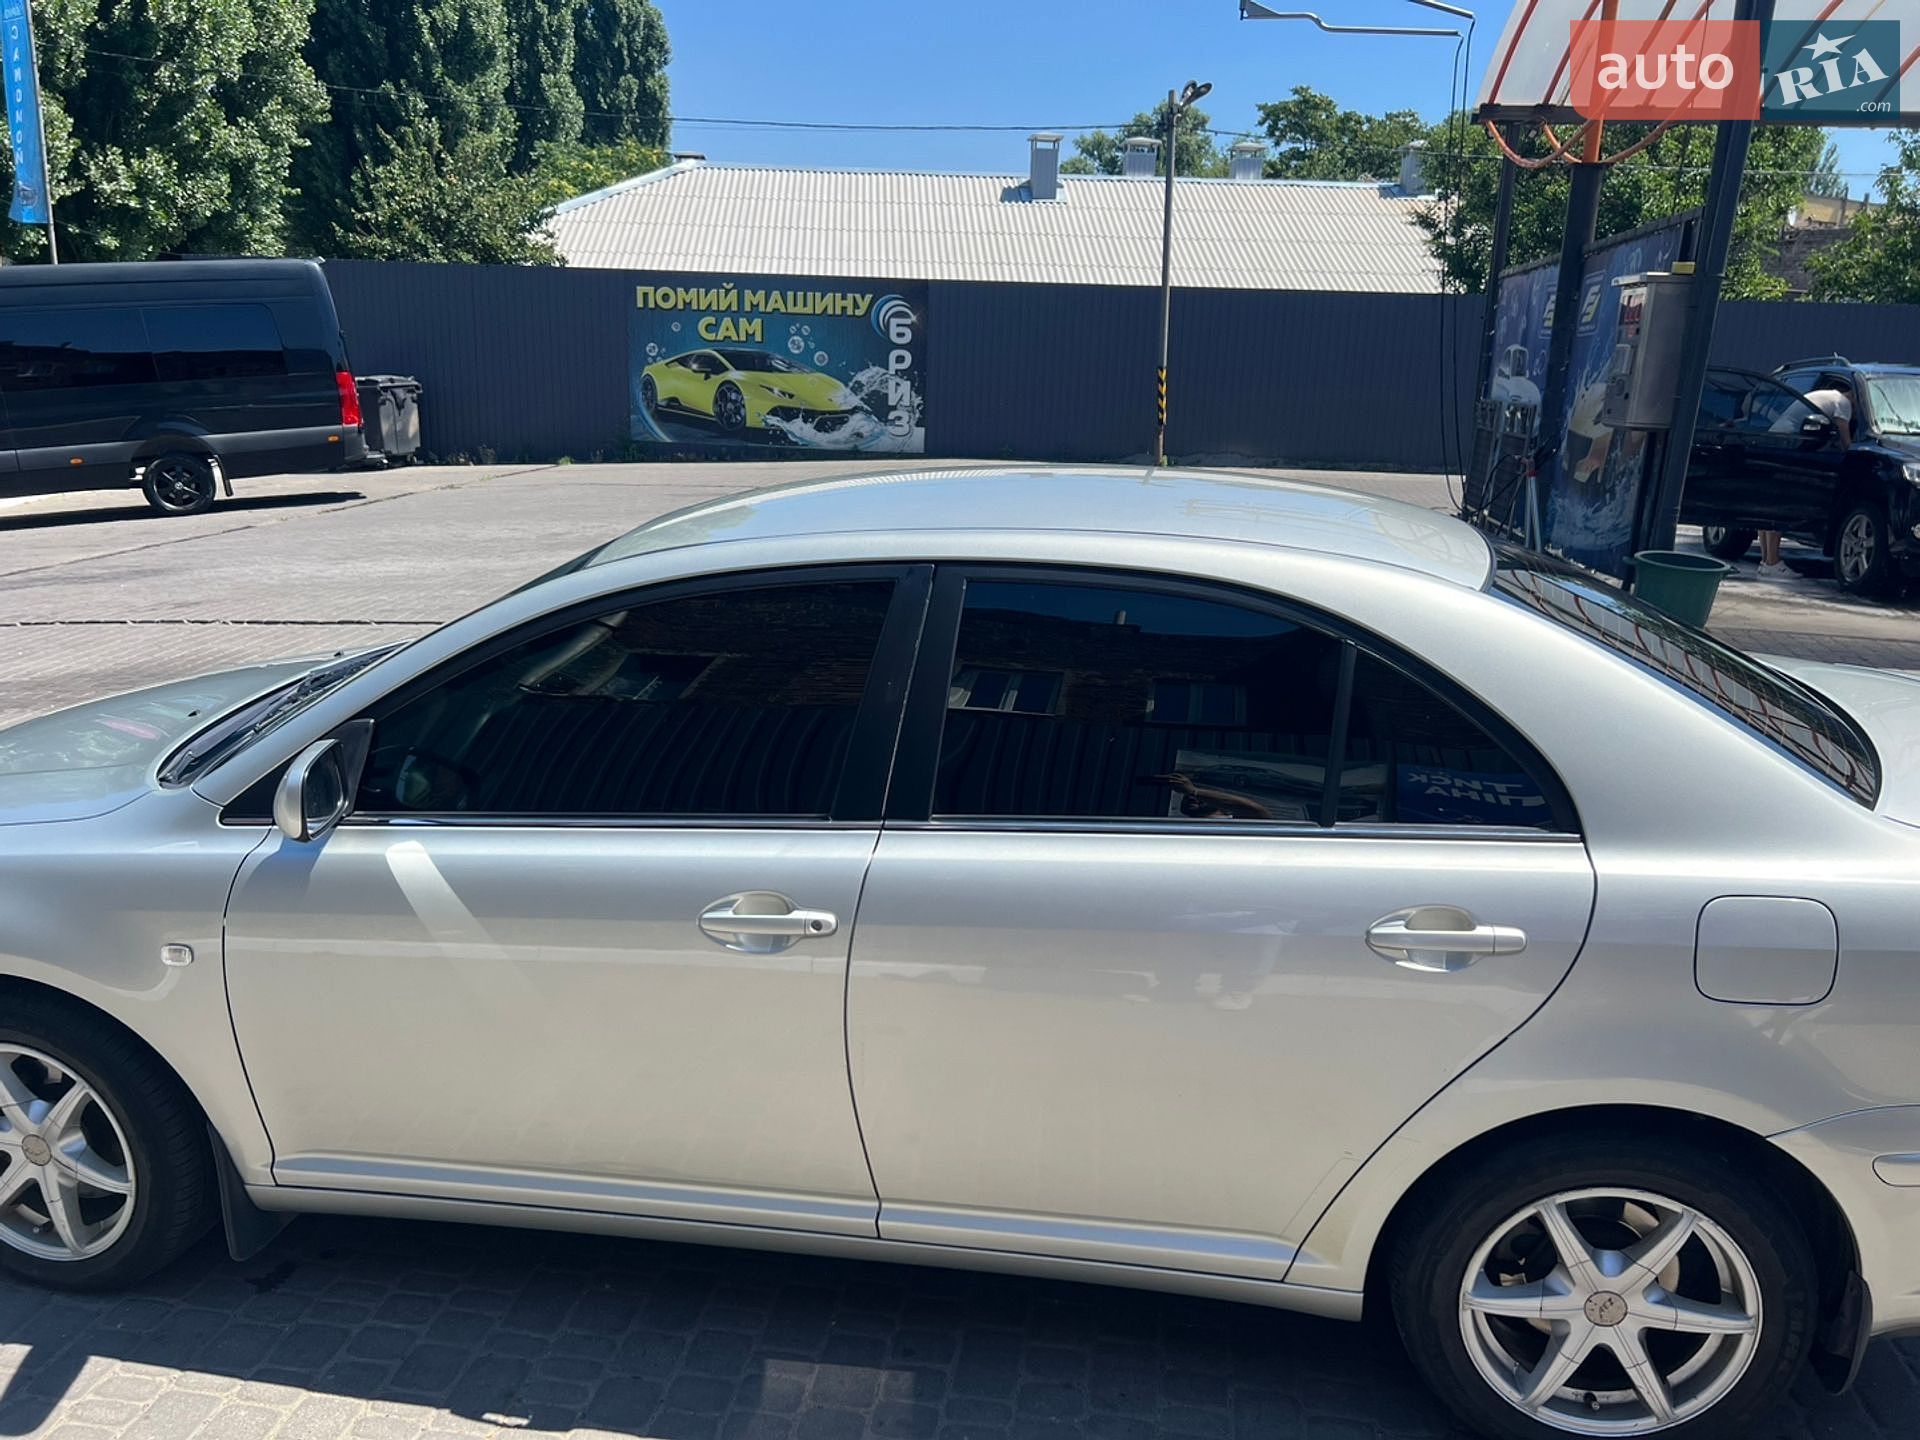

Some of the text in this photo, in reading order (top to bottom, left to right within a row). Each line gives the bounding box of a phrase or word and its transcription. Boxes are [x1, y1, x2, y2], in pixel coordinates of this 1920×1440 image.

[636, 283, 874, 318] ПОМИЙ МАШИНУ
[697, 317, 763, 342] САМ
[887, 317, 912, 436] БРИЗ
